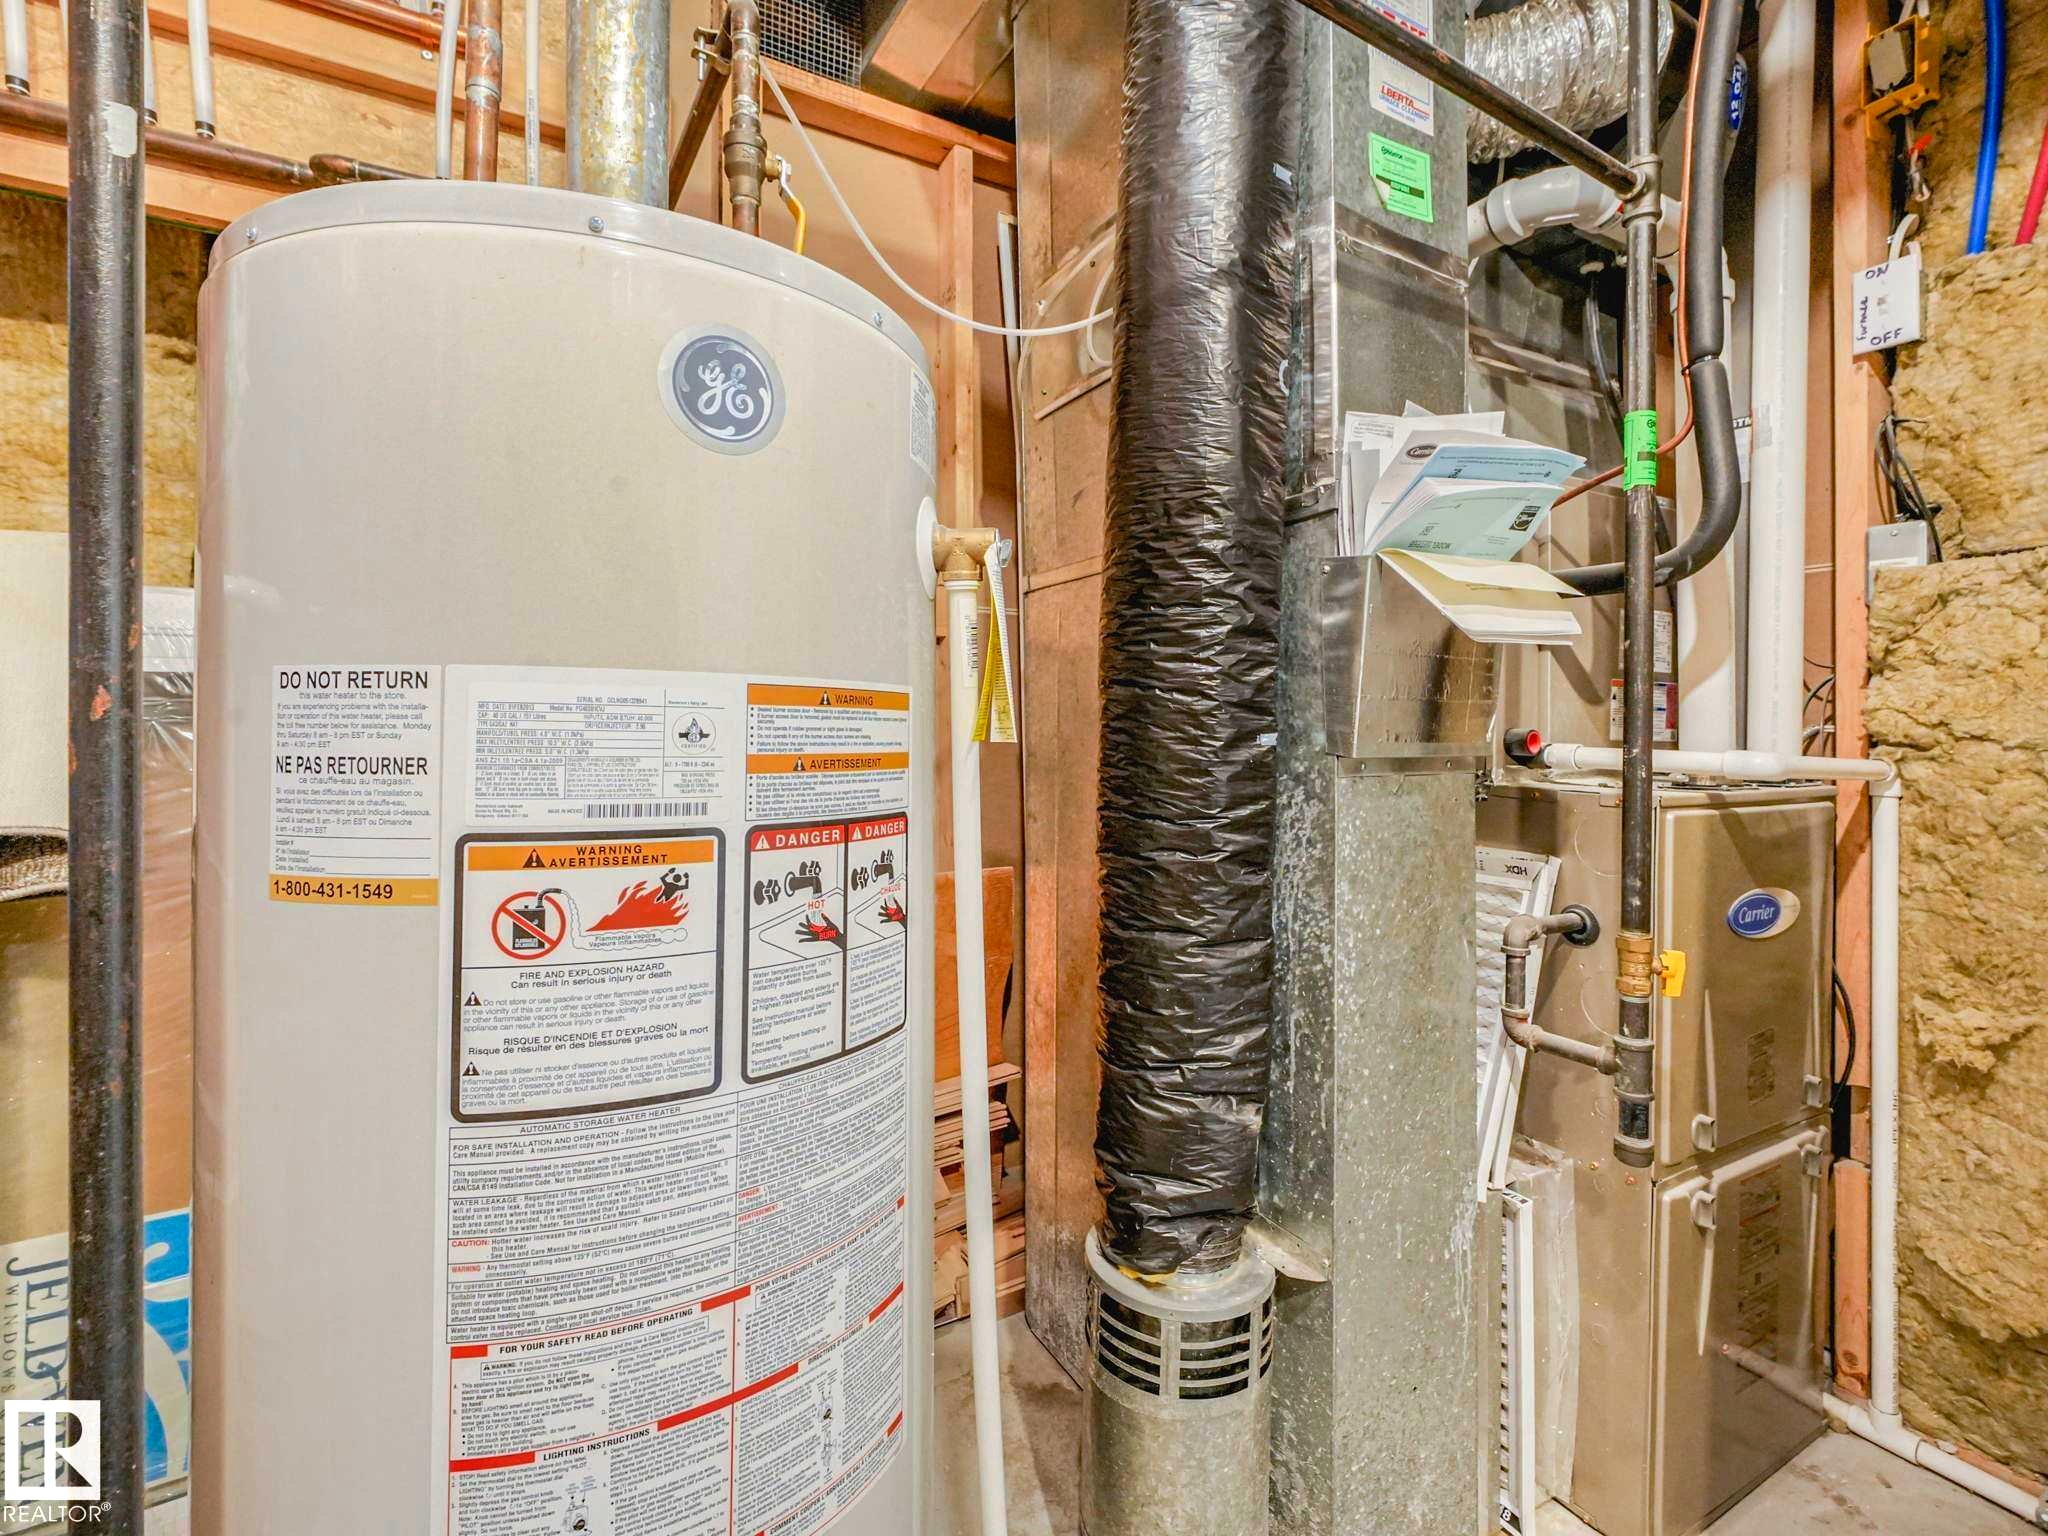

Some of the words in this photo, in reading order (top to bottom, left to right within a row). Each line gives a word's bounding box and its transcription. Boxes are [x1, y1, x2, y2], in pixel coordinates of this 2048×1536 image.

[1865, 263, 1889, 279] ON
[1870, 327, 1903, 346] OFF
[280, 671, 300, 689] DO
[307, 671, 341, 689] NOT
[348, 671, 428, 689] RETURN
[835, 695, 873, 705] WARNING
[403, 722, 431, 731] Monday
[376, 732, 401, 740] Sunday
[276, 756, 292, 773] NE
[297, 756, 321, 774] PAS
[328, 757, 428, 775] RETOURNER
[810, 758, 882, 769] AVERTISSEMENT
[310, 776, 356, 784] chauffe-eau
[373, 778, 414, 786] magasin.
[865, 821, 905, 838] DANGER
[775, 830, 841, 847] DANGER
[576, 845, 642, 856] WARNING
[550, 855, 668, 868] AVERTISSEMENT
[1504, 863, 1528, 876] HDX
[273, 880, 393, 898] 1-800-431-1549
[808, 899, 825, 910] HOT
[1738, 904, 1775, 924] Carrier
[819, 929, 837, 940] BURN
[532, 979, 558, 987] result
[572, 977, 606, 986] serious
[609, 974, 633, 984] injury
[648, 970, 672, 979] death
[568, 966, 623, 979] EXPLOSION
[626, 963, 664, 973] HAZARD
[614, 989, 649, 998] flammable
[616, 1006, 639, 1015] vicinity
[620, 998, 647, 1007] Storage
[468, 1048, 501, 1056] Risque
[503, 1046, 514, 1054] de
[569, 1040, 585, 1049] des
[588, 1037, 632, 1048] blessures
[635, 1033, 663, 1044] graves
[689, 1026, 709, 1035] mort
[504, 1037, 540, 1046] RISQUE
[544, 1032, 597, 1043] D'INCENDIE
[602, 1030, 613, 1039] ET
[616, 1023, 677, 1037] D'EXPLOSION
[520, 1122, 571, 1134] AUTOMATIC
[573, 1116, 614, 1129] STORAGE
[617, 1114, 646, 1122] WATER
[649, 1107, 680, 1117] HEATER
[495, 1140, 552, 1149] INSTALLATION
[573, 1131, 619, 1143] OPERATION
[481, 1197, 517, 1205] LEAKAGE
[1, 1283, 19, 1395] WINDOWS
[500, 1346, 517, 1354] FOR
[521, 1342, 545, 1352] YOUR
[548, 1336, 581, 1348] SAFETY
[585, 1329, 608, 1341] READ
[611, 1324, 644, 1336] BEFORE
[647, 1309, 693, 1326] OPERATING
[543, 1446, 584, 1461] LIGHTING
[587, 1428, 650, 1454] INSTRUCTIONS
[1502, 1508, 1512, 1521] 8
